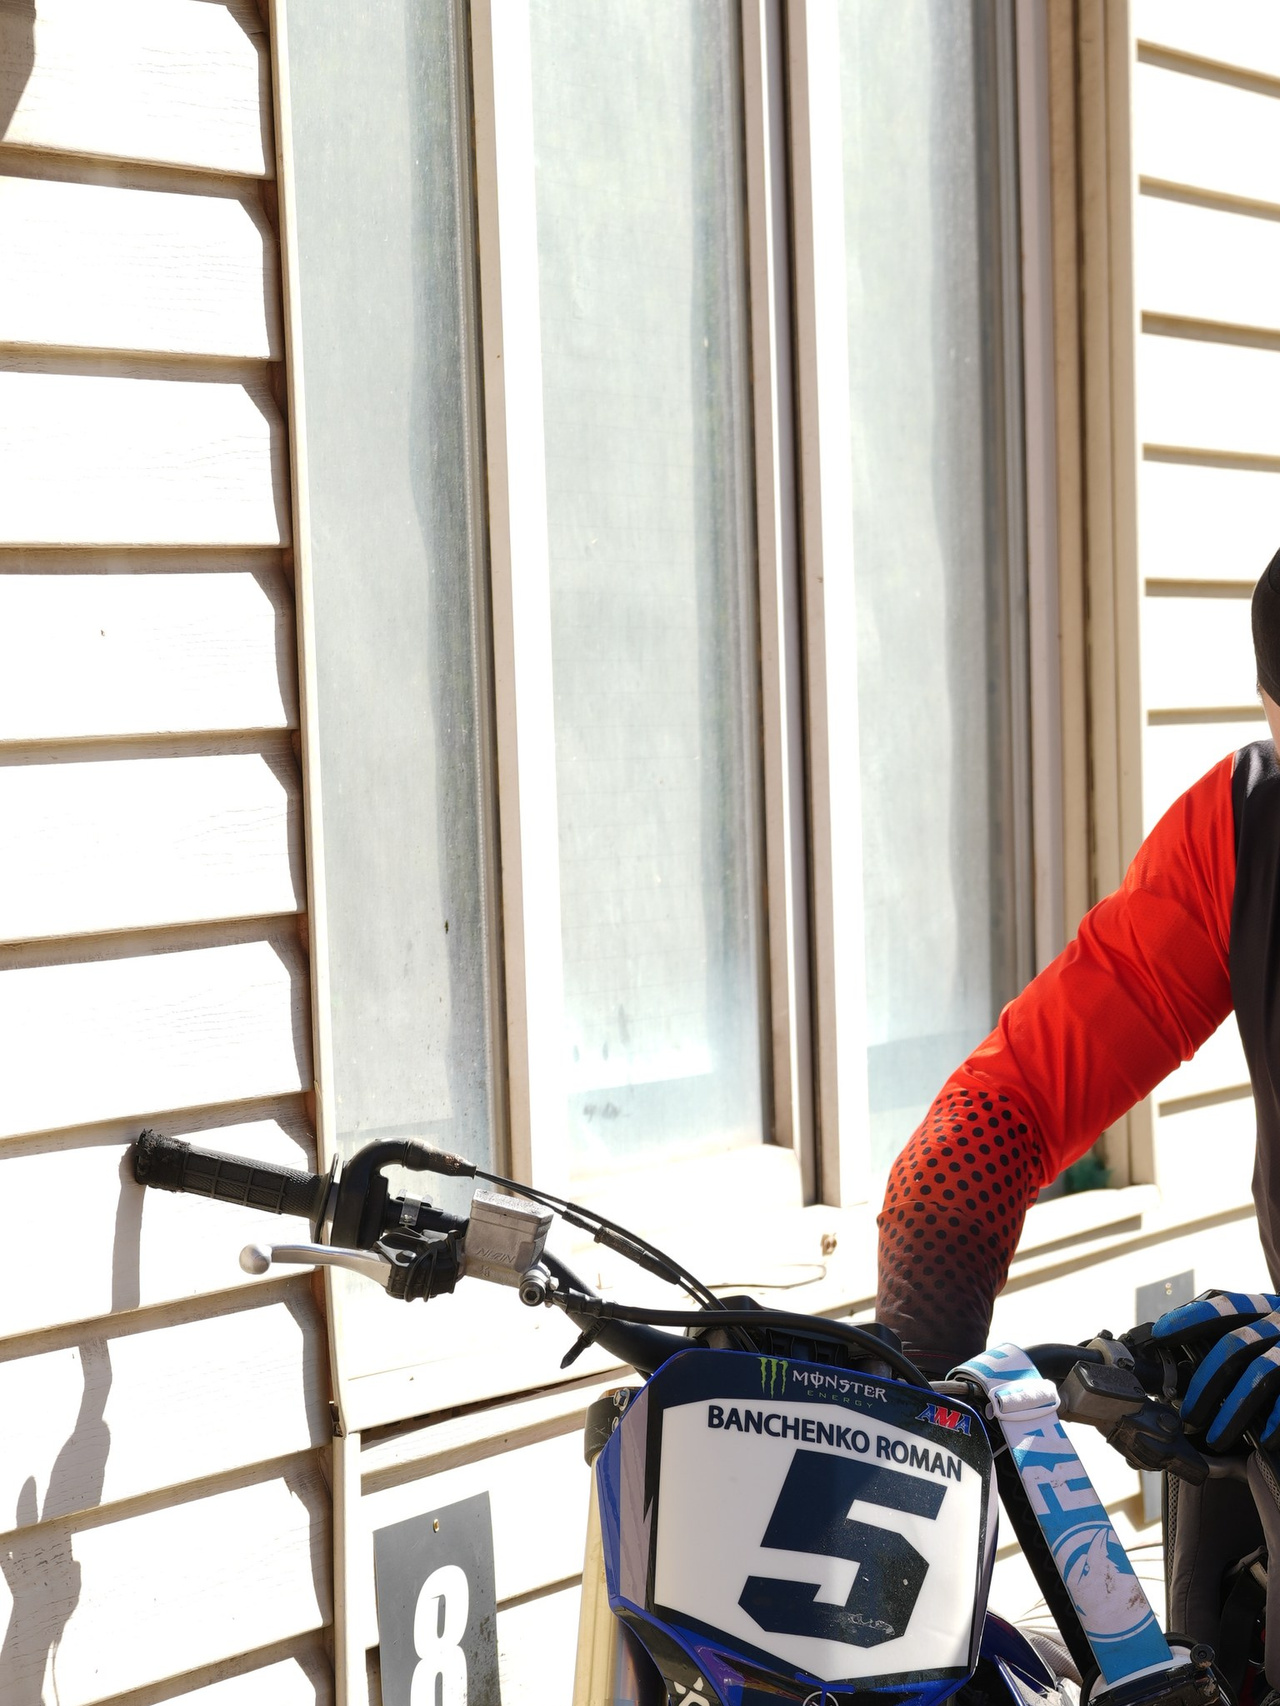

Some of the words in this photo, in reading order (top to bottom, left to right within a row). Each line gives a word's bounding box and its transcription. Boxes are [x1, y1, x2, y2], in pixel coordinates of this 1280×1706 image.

[792, 1370, 888, 1402] MONSTER
[807, 1389, 873, 1409] ENERGY
[915, 1402, 972, 1436] AMA
[707, 1405, 870, 1454] BANCHENKO
[876, 1430, 962, 1482] ROMAN
[738, 1448, 948, 1649] 5
